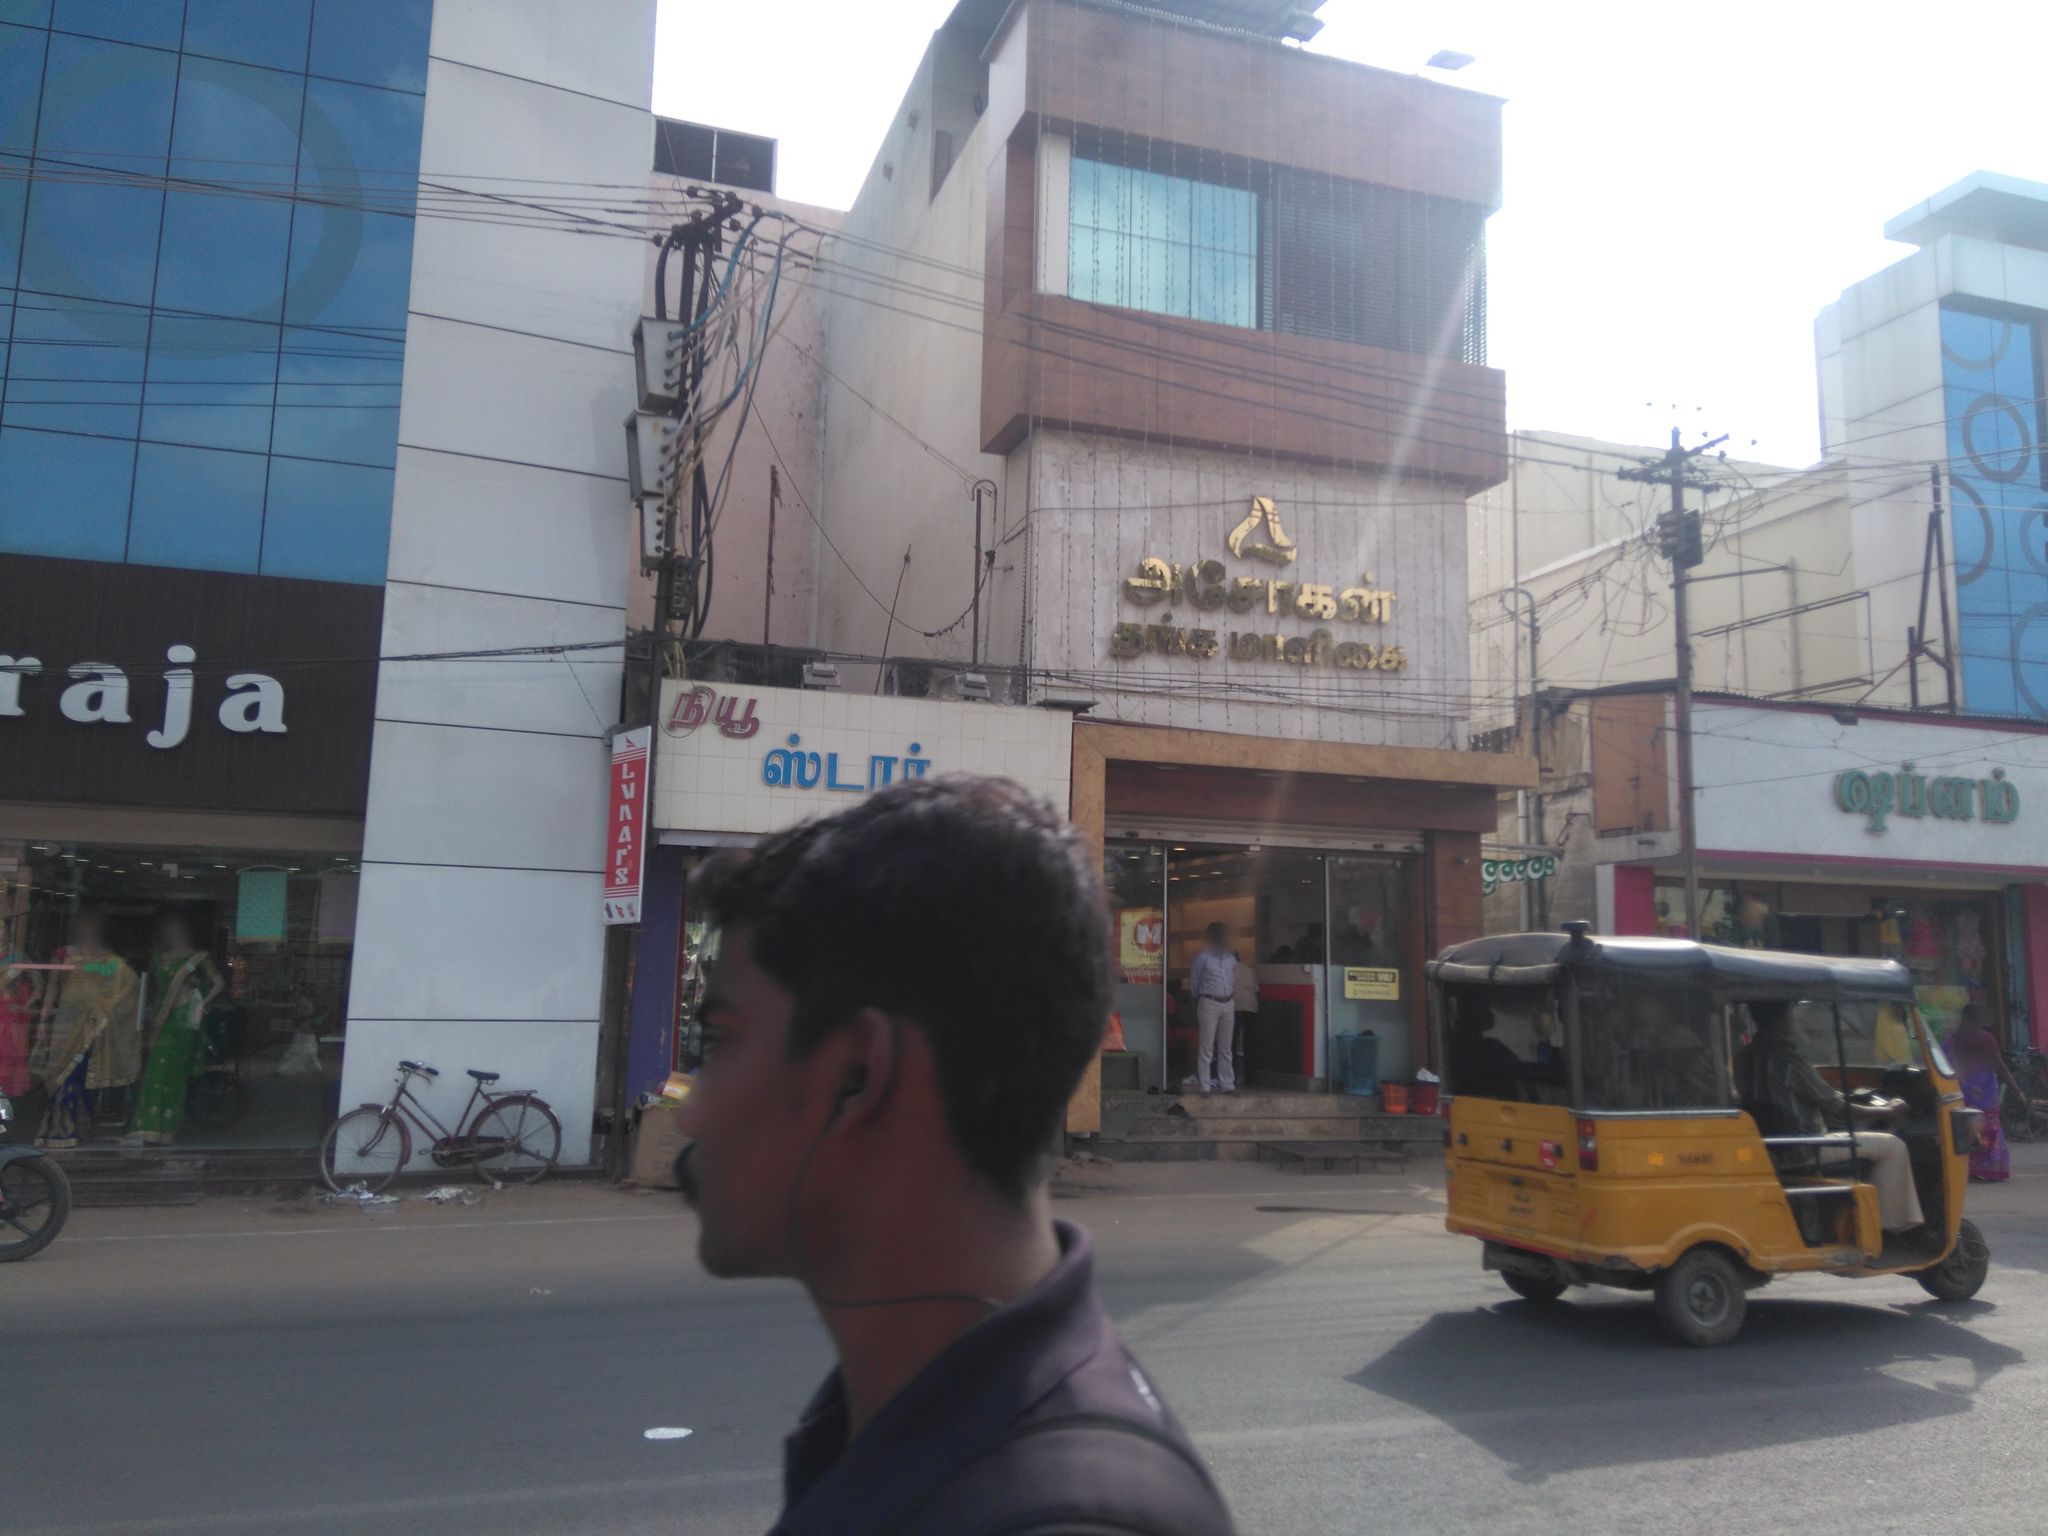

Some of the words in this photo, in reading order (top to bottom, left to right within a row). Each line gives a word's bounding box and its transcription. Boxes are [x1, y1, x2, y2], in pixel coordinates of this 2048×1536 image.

[1123, 557, 1397, 625] அசோகன்
[1110, 612, 1218, 660] தங்க
[1229, 628, 1408, 672] மாளிகை
[0, 645, 288, 750] raja
[668, 685, 760, 738] நியூ
[762, 733, 932, 792] ஸ்டார்
